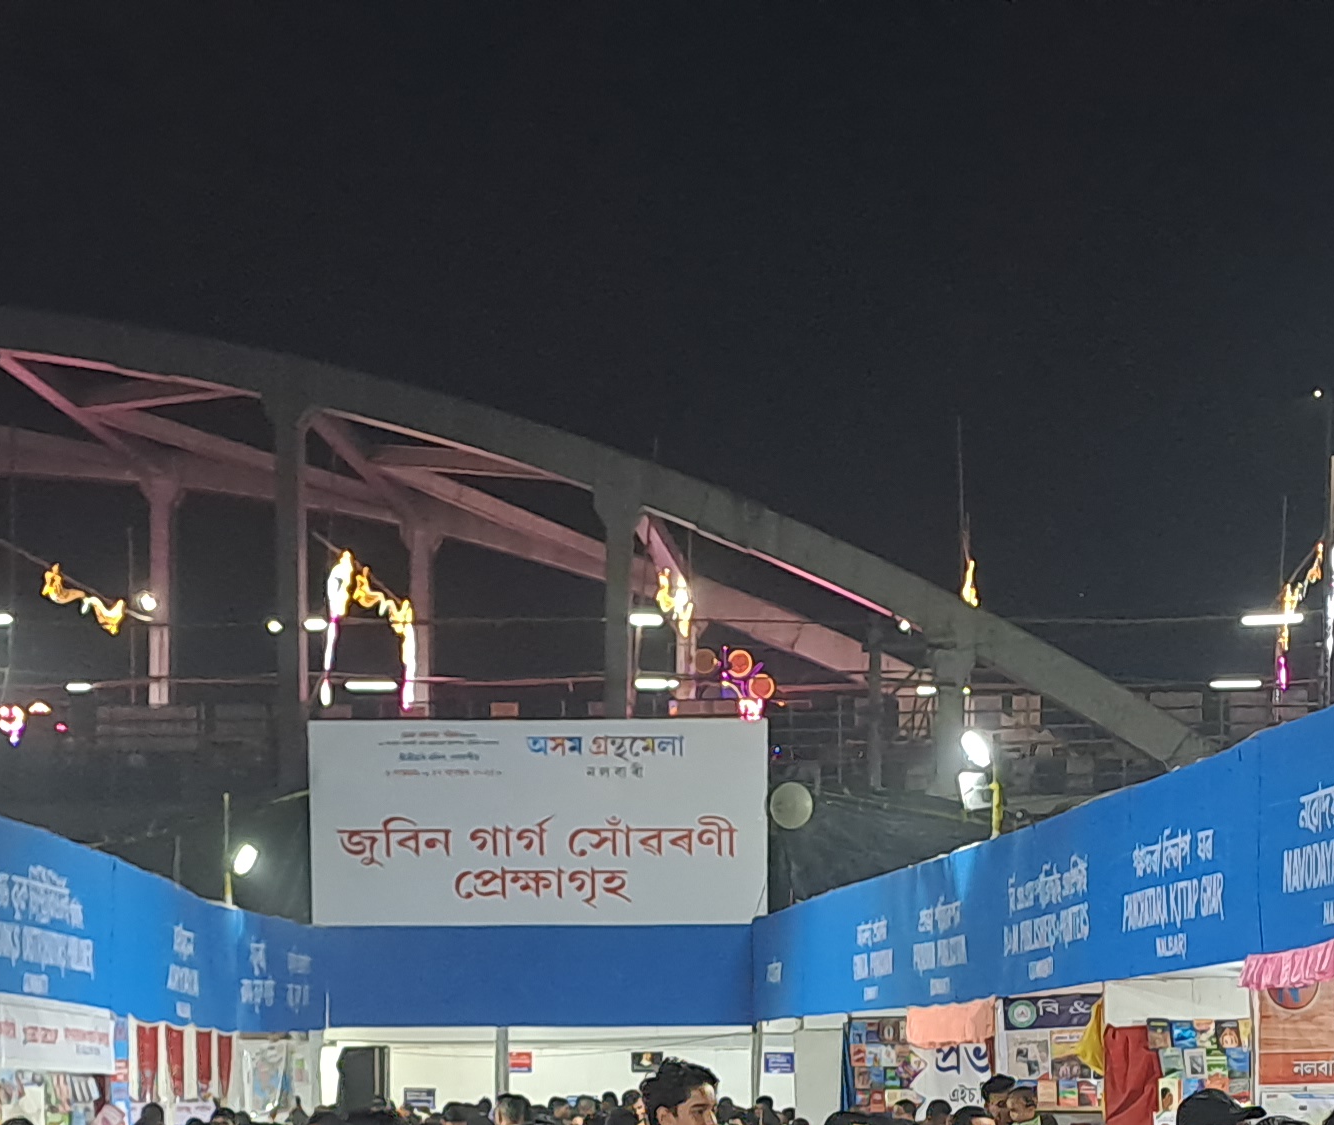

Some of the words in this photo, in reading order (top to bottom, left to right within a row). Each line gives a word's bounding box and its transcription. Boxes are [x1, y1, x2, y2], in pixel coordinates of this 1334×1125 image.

[526, 735, 583, 757] অসম
[336, 815, 453, 868] জুবিন
[568, 815, 739, 859] সোঁৱৰণী
[454, 866, 633, 909] প্ৰেক্ষাগৃহ
